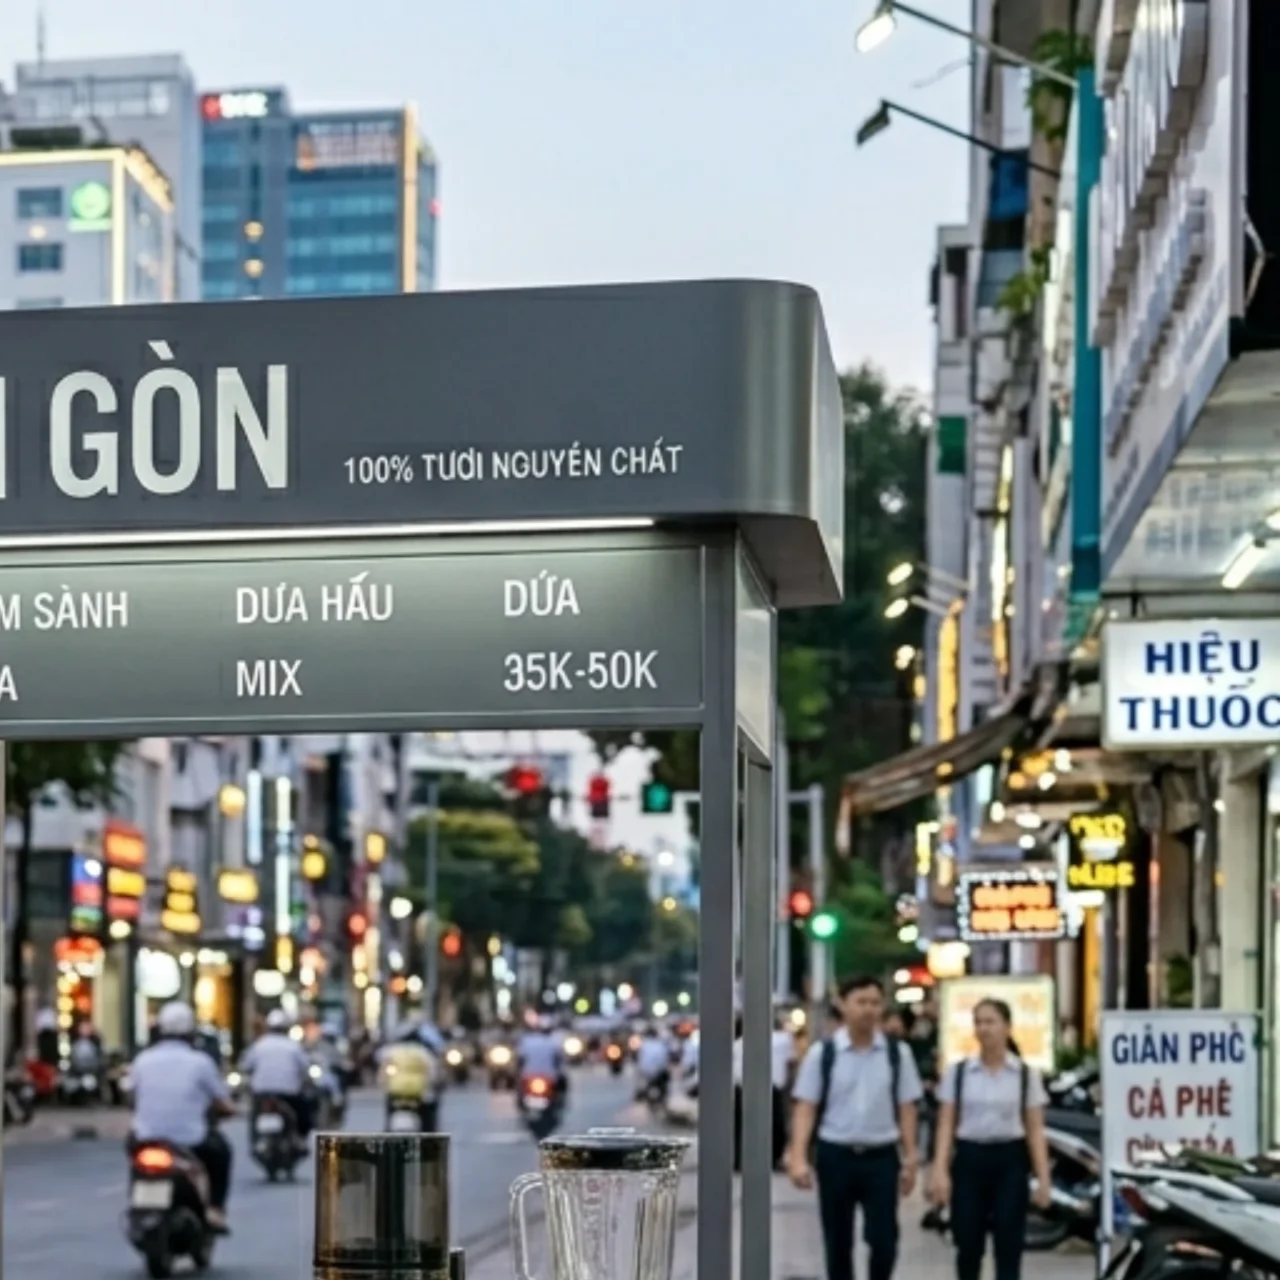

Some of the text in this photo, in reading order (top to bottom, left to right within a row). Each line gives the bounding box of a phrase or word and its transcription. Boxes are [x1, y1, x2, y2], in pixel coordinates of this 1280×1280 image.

[49, 340, 288, 498] GÒN
[344, 454, 414, 484] 100%
[422, 447, 484, 481] TƯƠI
[34, 584, 128, 629] SÀNH
[236, 582, 308, 623] DƯA
[503, 568, 580, 617] DỨA
[236, 658, 303, 697] MIX
[503, 650, 659, 692] 35K-50K
[1145, 630, 1261, 684] HIỆU
[1118, 676, 1280, 731] THUỐC
